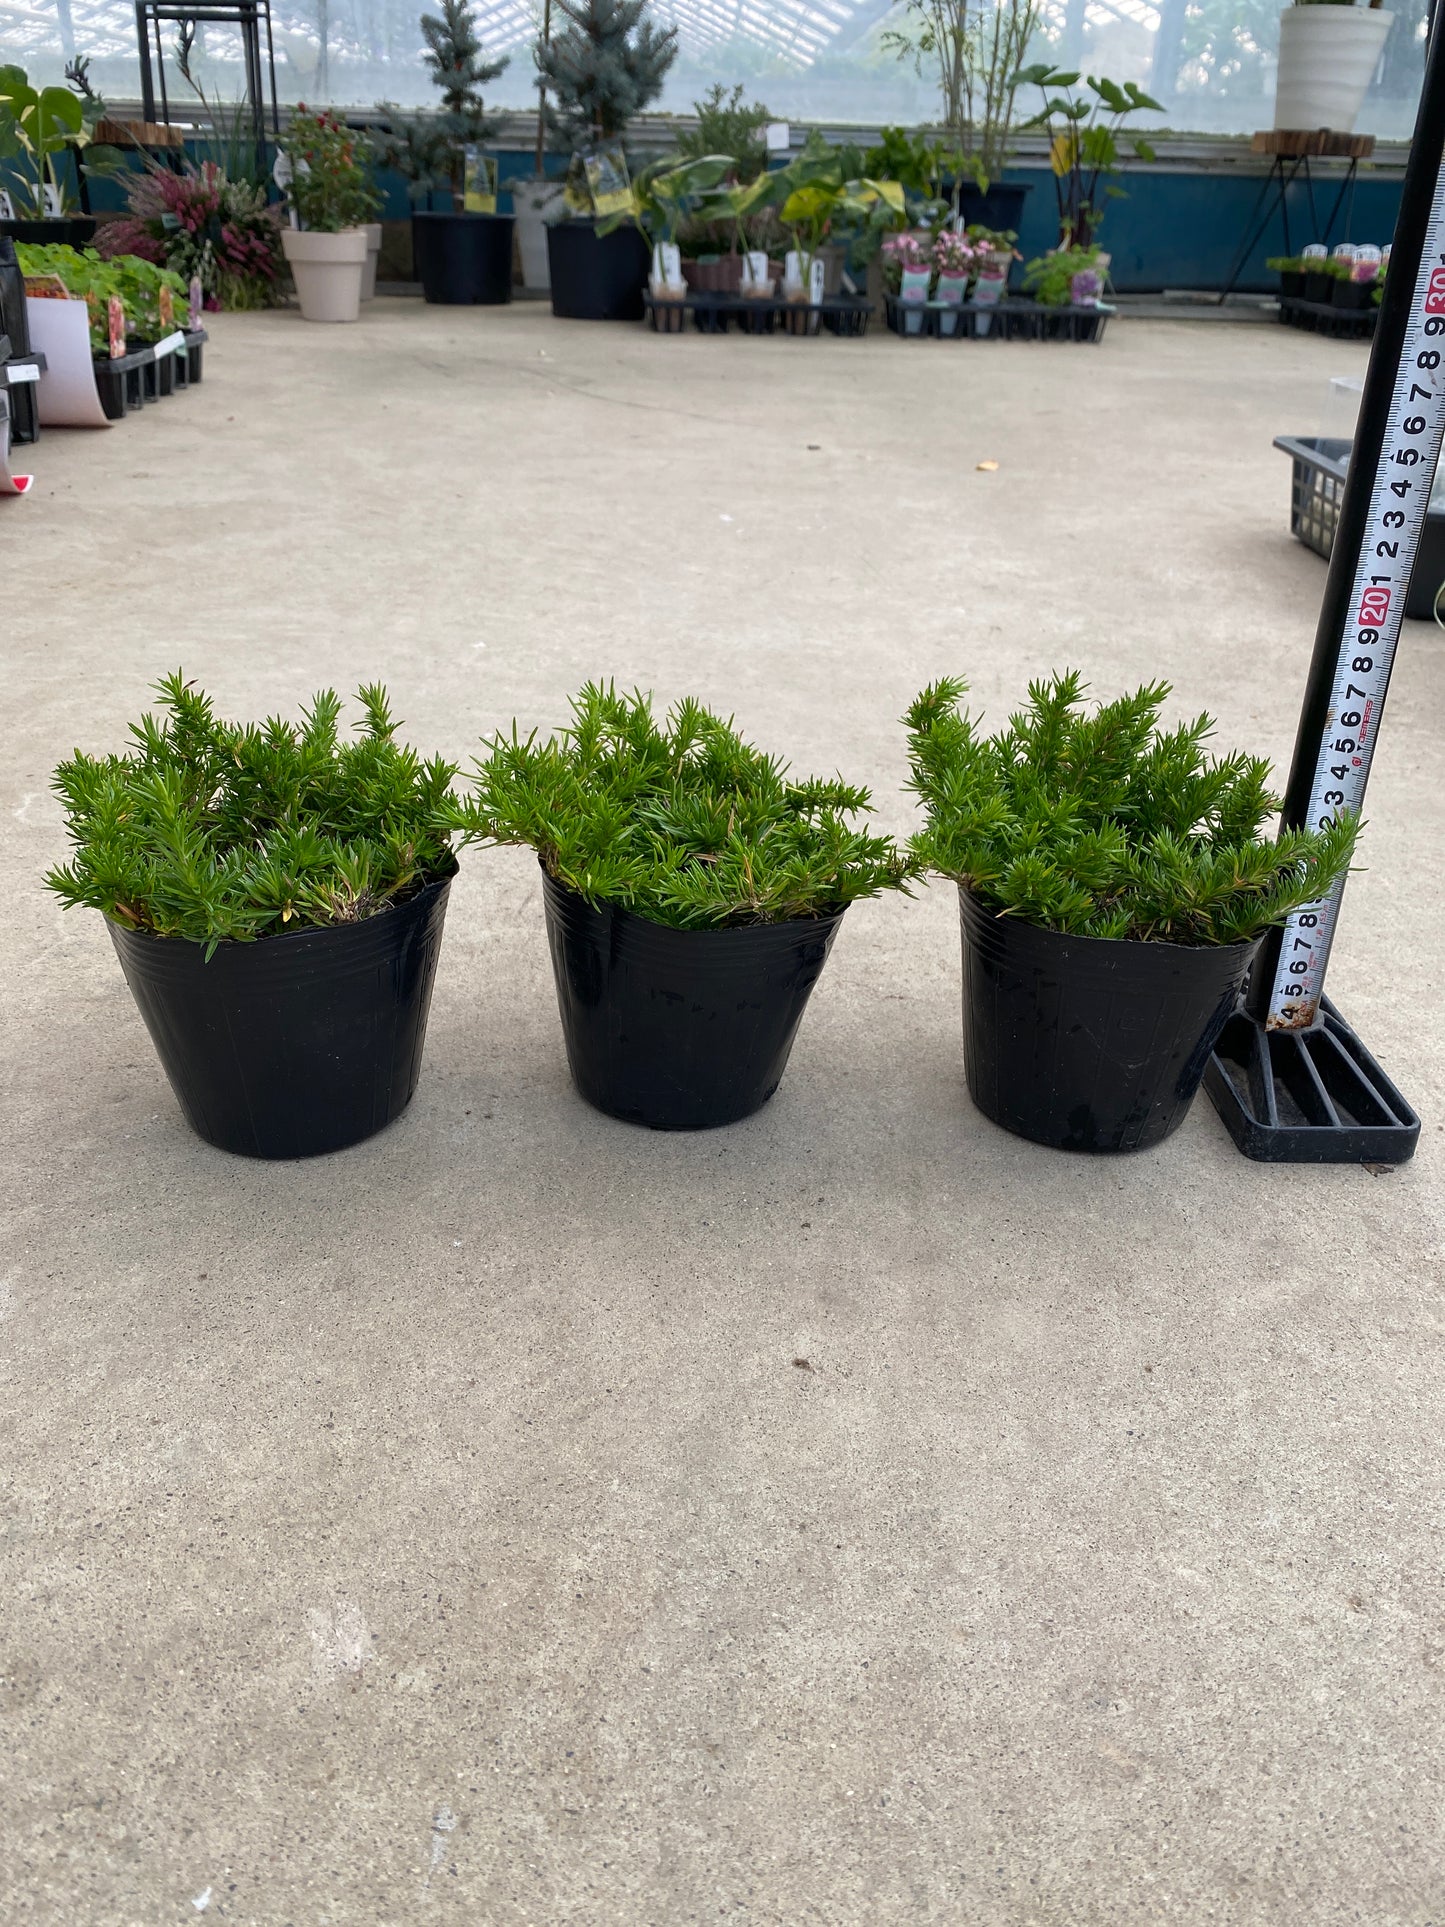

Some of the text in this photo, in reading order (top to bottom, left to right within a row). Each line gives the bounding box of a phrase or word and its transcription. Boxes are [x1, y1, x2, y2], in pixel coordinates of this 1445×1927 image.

[1424, 317, 1445, 336] 9
[1417, 351, 1440, 369] 8
[1409, 384, 1432, 402] 7
[1403, 417, 1426, 434] 6
[1396, 449, 1418, 466] 5
[1391, 480, 1412, 498] 4
[1383, 511, 1405, 528] 3
[1377, 541, 1399, 558] 2
[1371, 576, 1391, 585] 1
[1361, 591, 1388, 621] 20
[1358, 629, 1379, 644] 9
[1352, 657, 1373, 672] 8
[1346, 684, 1366, 699] 7
[1341, 712, 1361, 727] 6
[1335, 739, 1355, 753] 5
[1331, 765, 1350, 780] 4
[1324, 791, 1344, 805] 3
[1299, 914, 1317, 928] 8
[1294, 938, 1311, 951] 7
[1290, 961, 1307, 974] 6
[1285, 984, 1303, 996] 5
